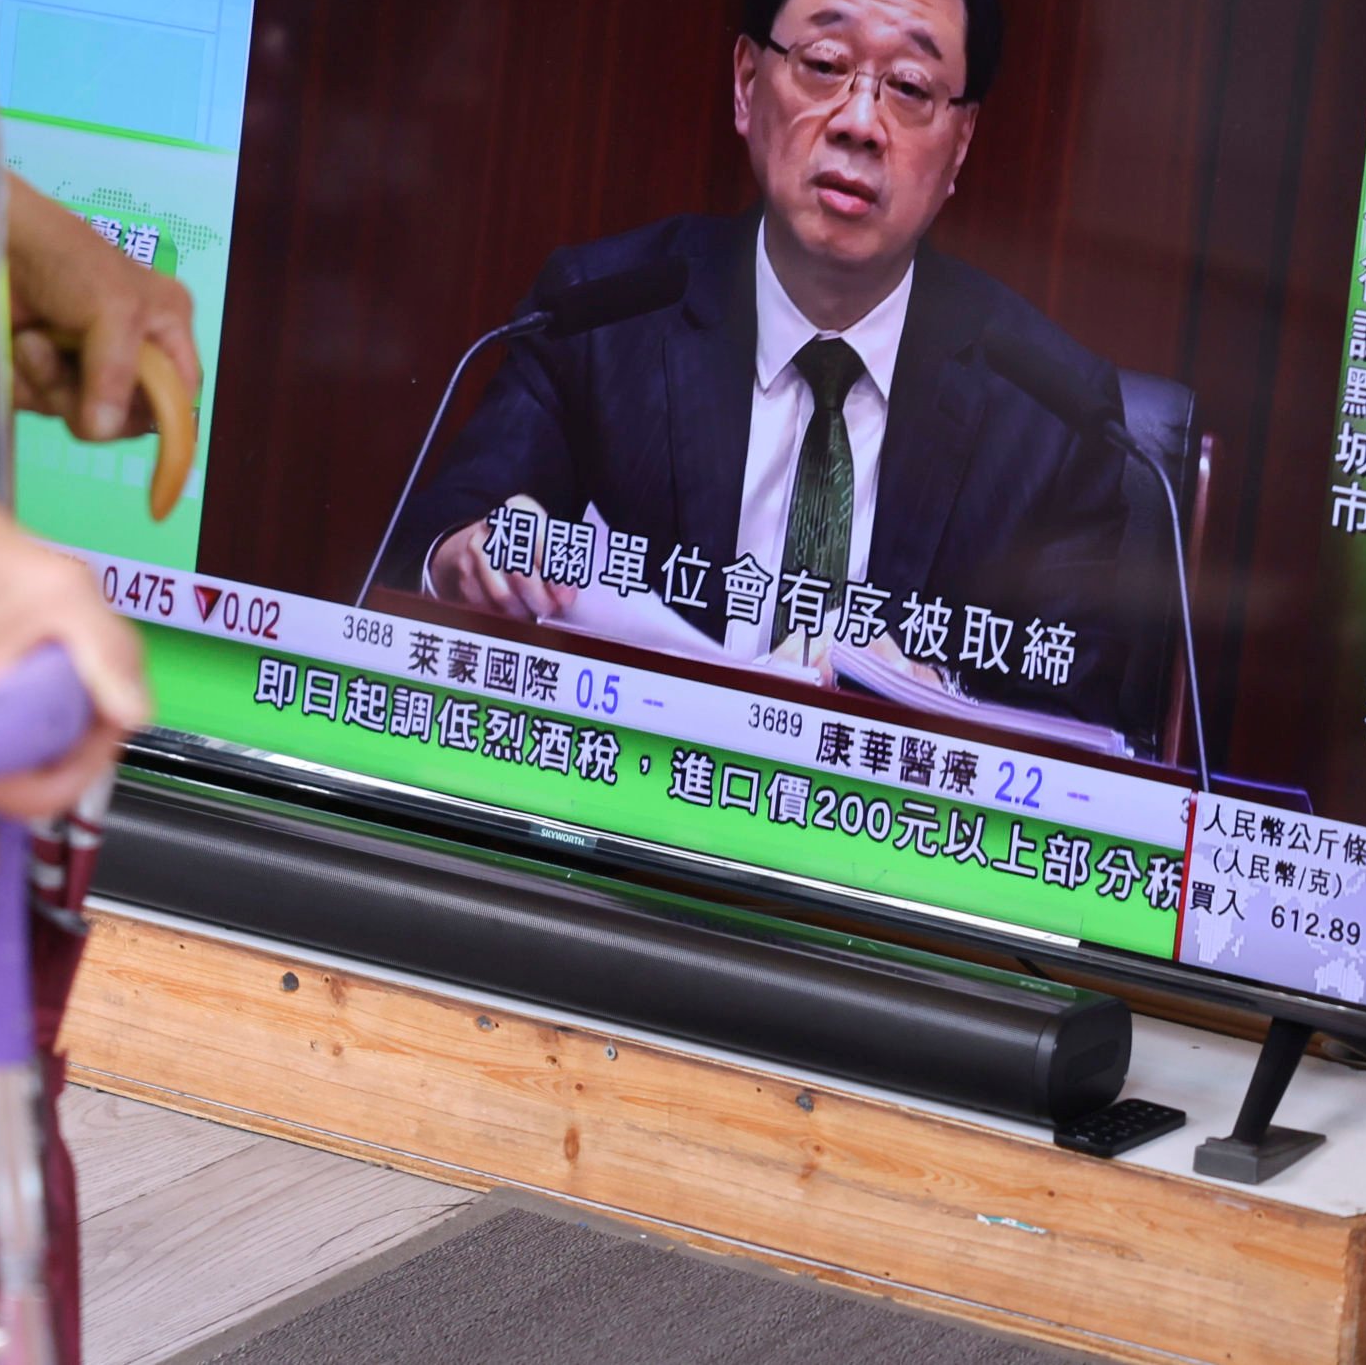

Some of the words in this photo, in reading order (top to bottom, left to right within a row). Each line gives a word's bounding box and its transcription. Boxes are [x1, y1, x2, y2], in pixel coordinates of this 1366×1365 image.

[484, 505, 1077, 687] 相關單位會有序被取締
[102, 565, 176, 617] 0.475
[222, 592, 281, 641] 0.02
[342, 614, 394, 649] 3688
[406, 629, 561, 704] 萊蒙國際
[575, 668, 620, 715] 0.5
[748, 703, 803, 739] 3689
[815, 720, 980, 797] 康華醫療
[994, 760, 1044, 809] 2.2
[540, 828, 585, 847] SKYWORTH
[1270, 904, 1361, 946] 612.89
